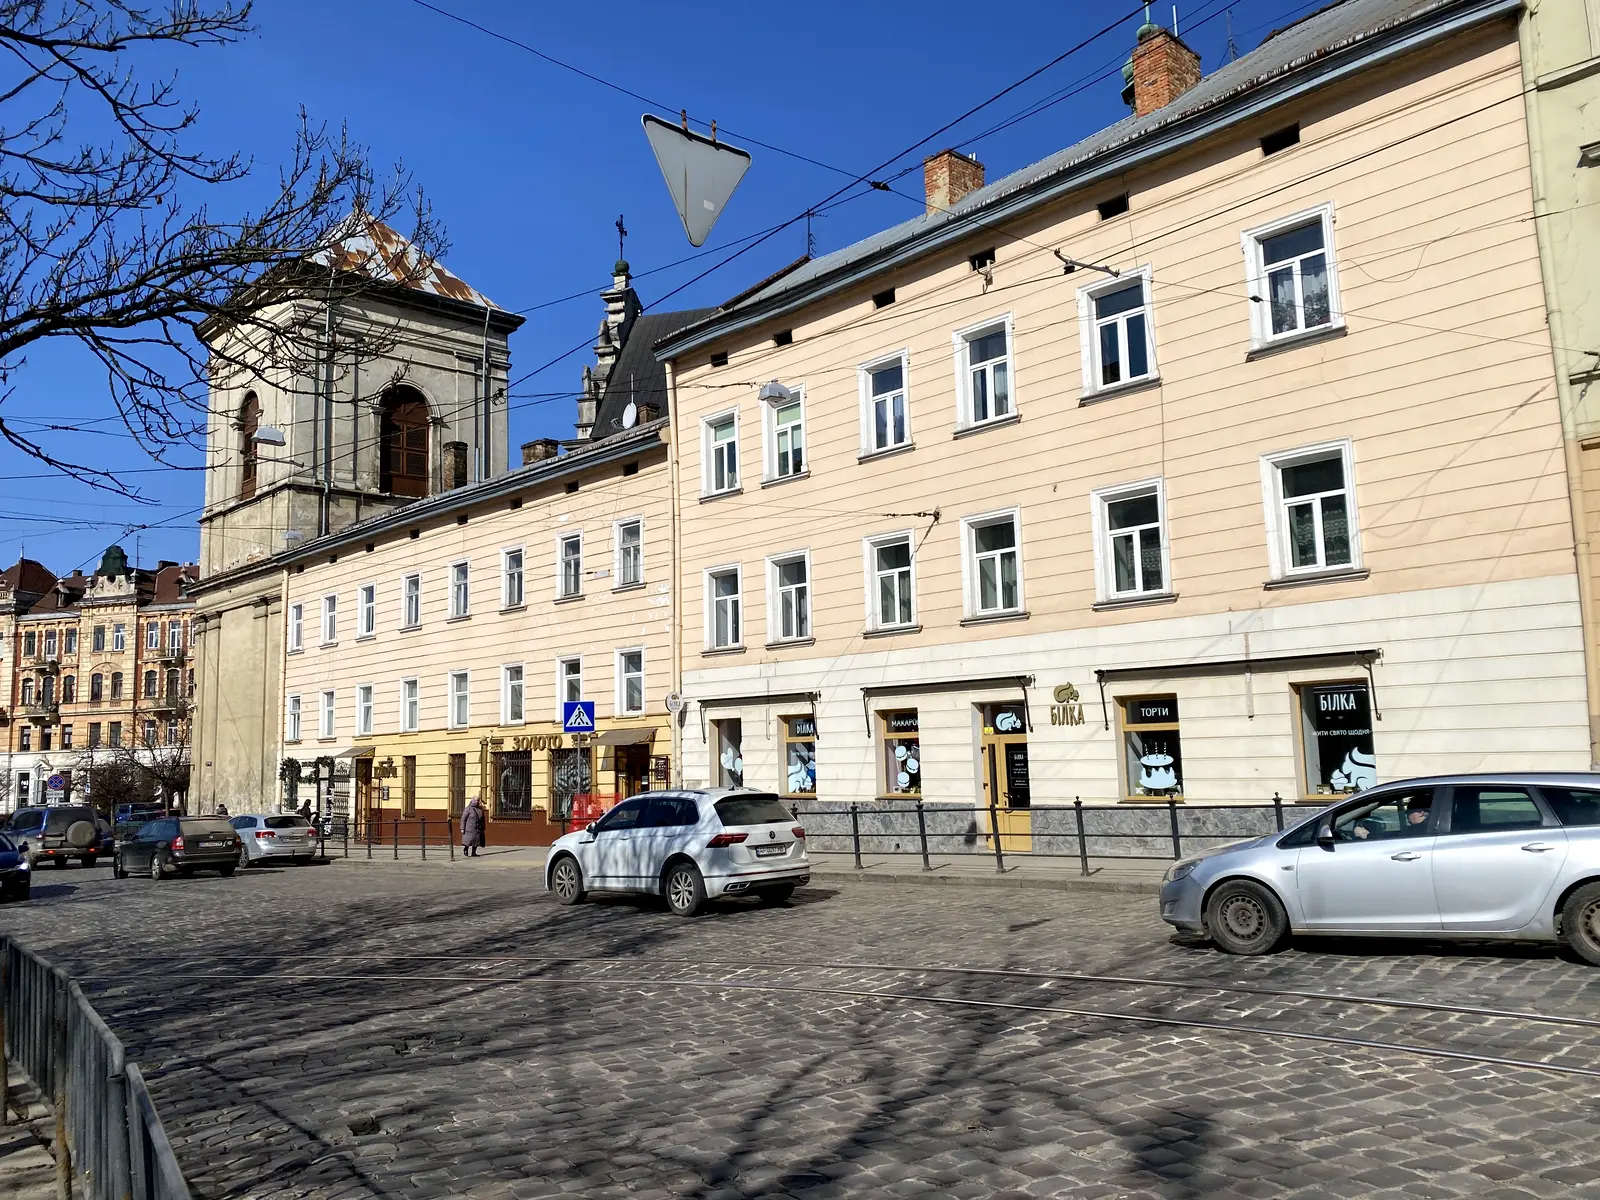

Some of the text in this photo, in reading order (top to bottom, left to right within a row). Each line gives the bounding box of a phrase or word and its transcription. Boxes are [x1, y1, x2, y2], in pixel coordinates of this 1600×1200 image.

[1320, 693, 1357, 711] БІЛКА
[1050, 704, 1085, 726] БІЛКА
[1141, 707, 1169, 717] ТОРТИ
[512, 735, 563, 751] ЗОЛОТО
